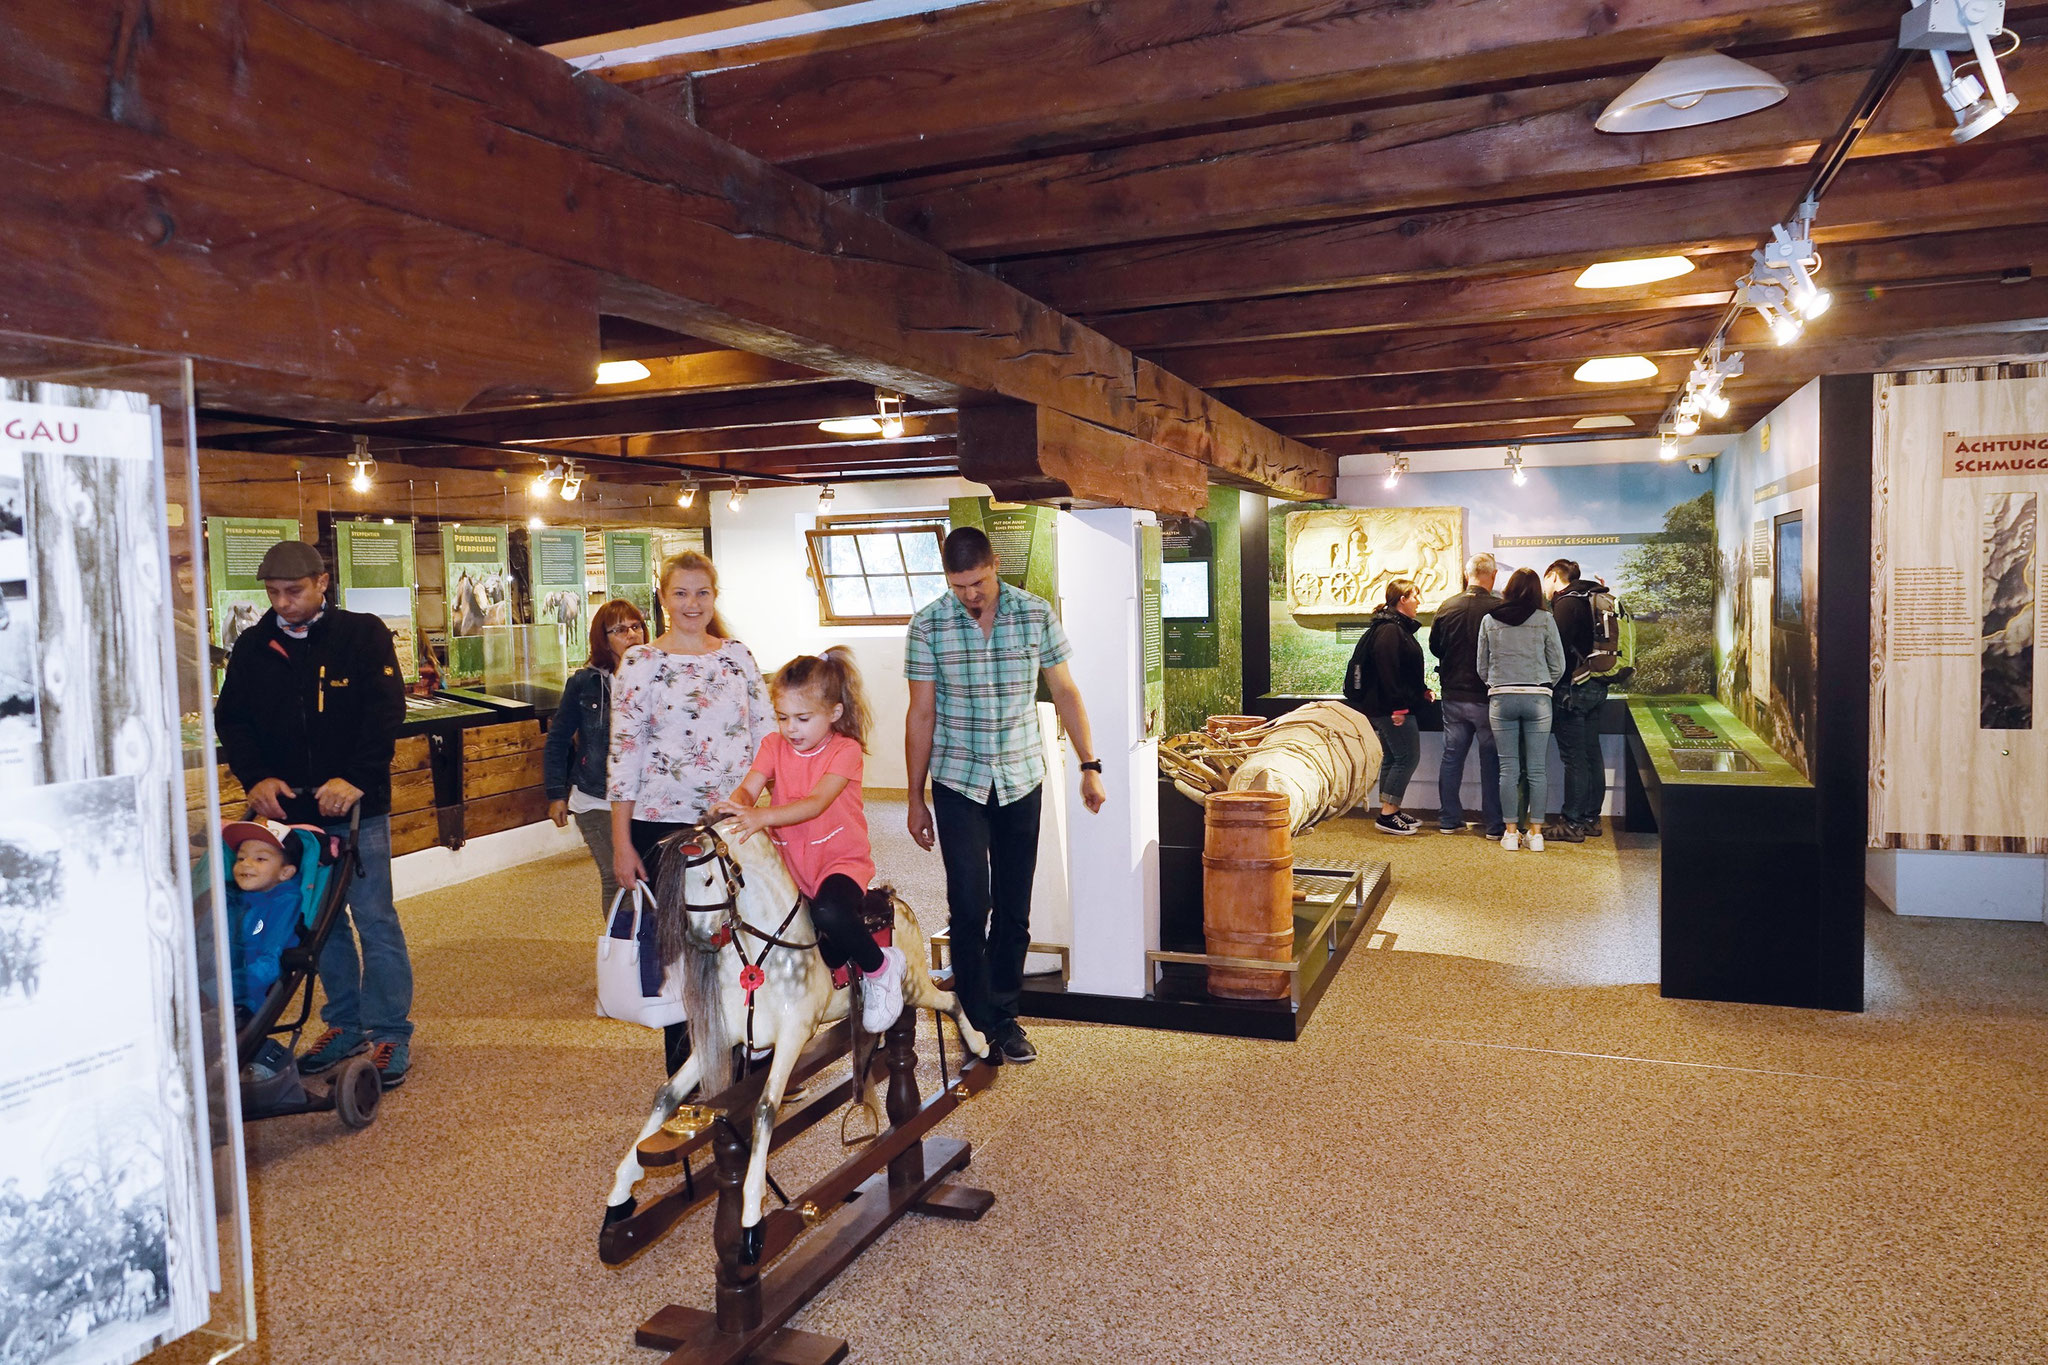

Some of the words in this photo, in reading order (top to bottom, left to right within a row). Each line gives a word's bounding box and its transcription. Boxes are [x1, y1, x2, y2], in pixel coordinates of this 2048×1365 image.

[0, 418, 78, 443] GAU
[1955, 439, 2048, 453] ACHTUNG
[455, 535, 496, 543] PFERDELEBEN
[1498, 539, 1512, 547] EIN
[1515, 537, 1543, 546] PFERD
[1565, 536, 1620, 544] GESCHICHTE
[456, 545, 496, 553] PFERDESEELE
